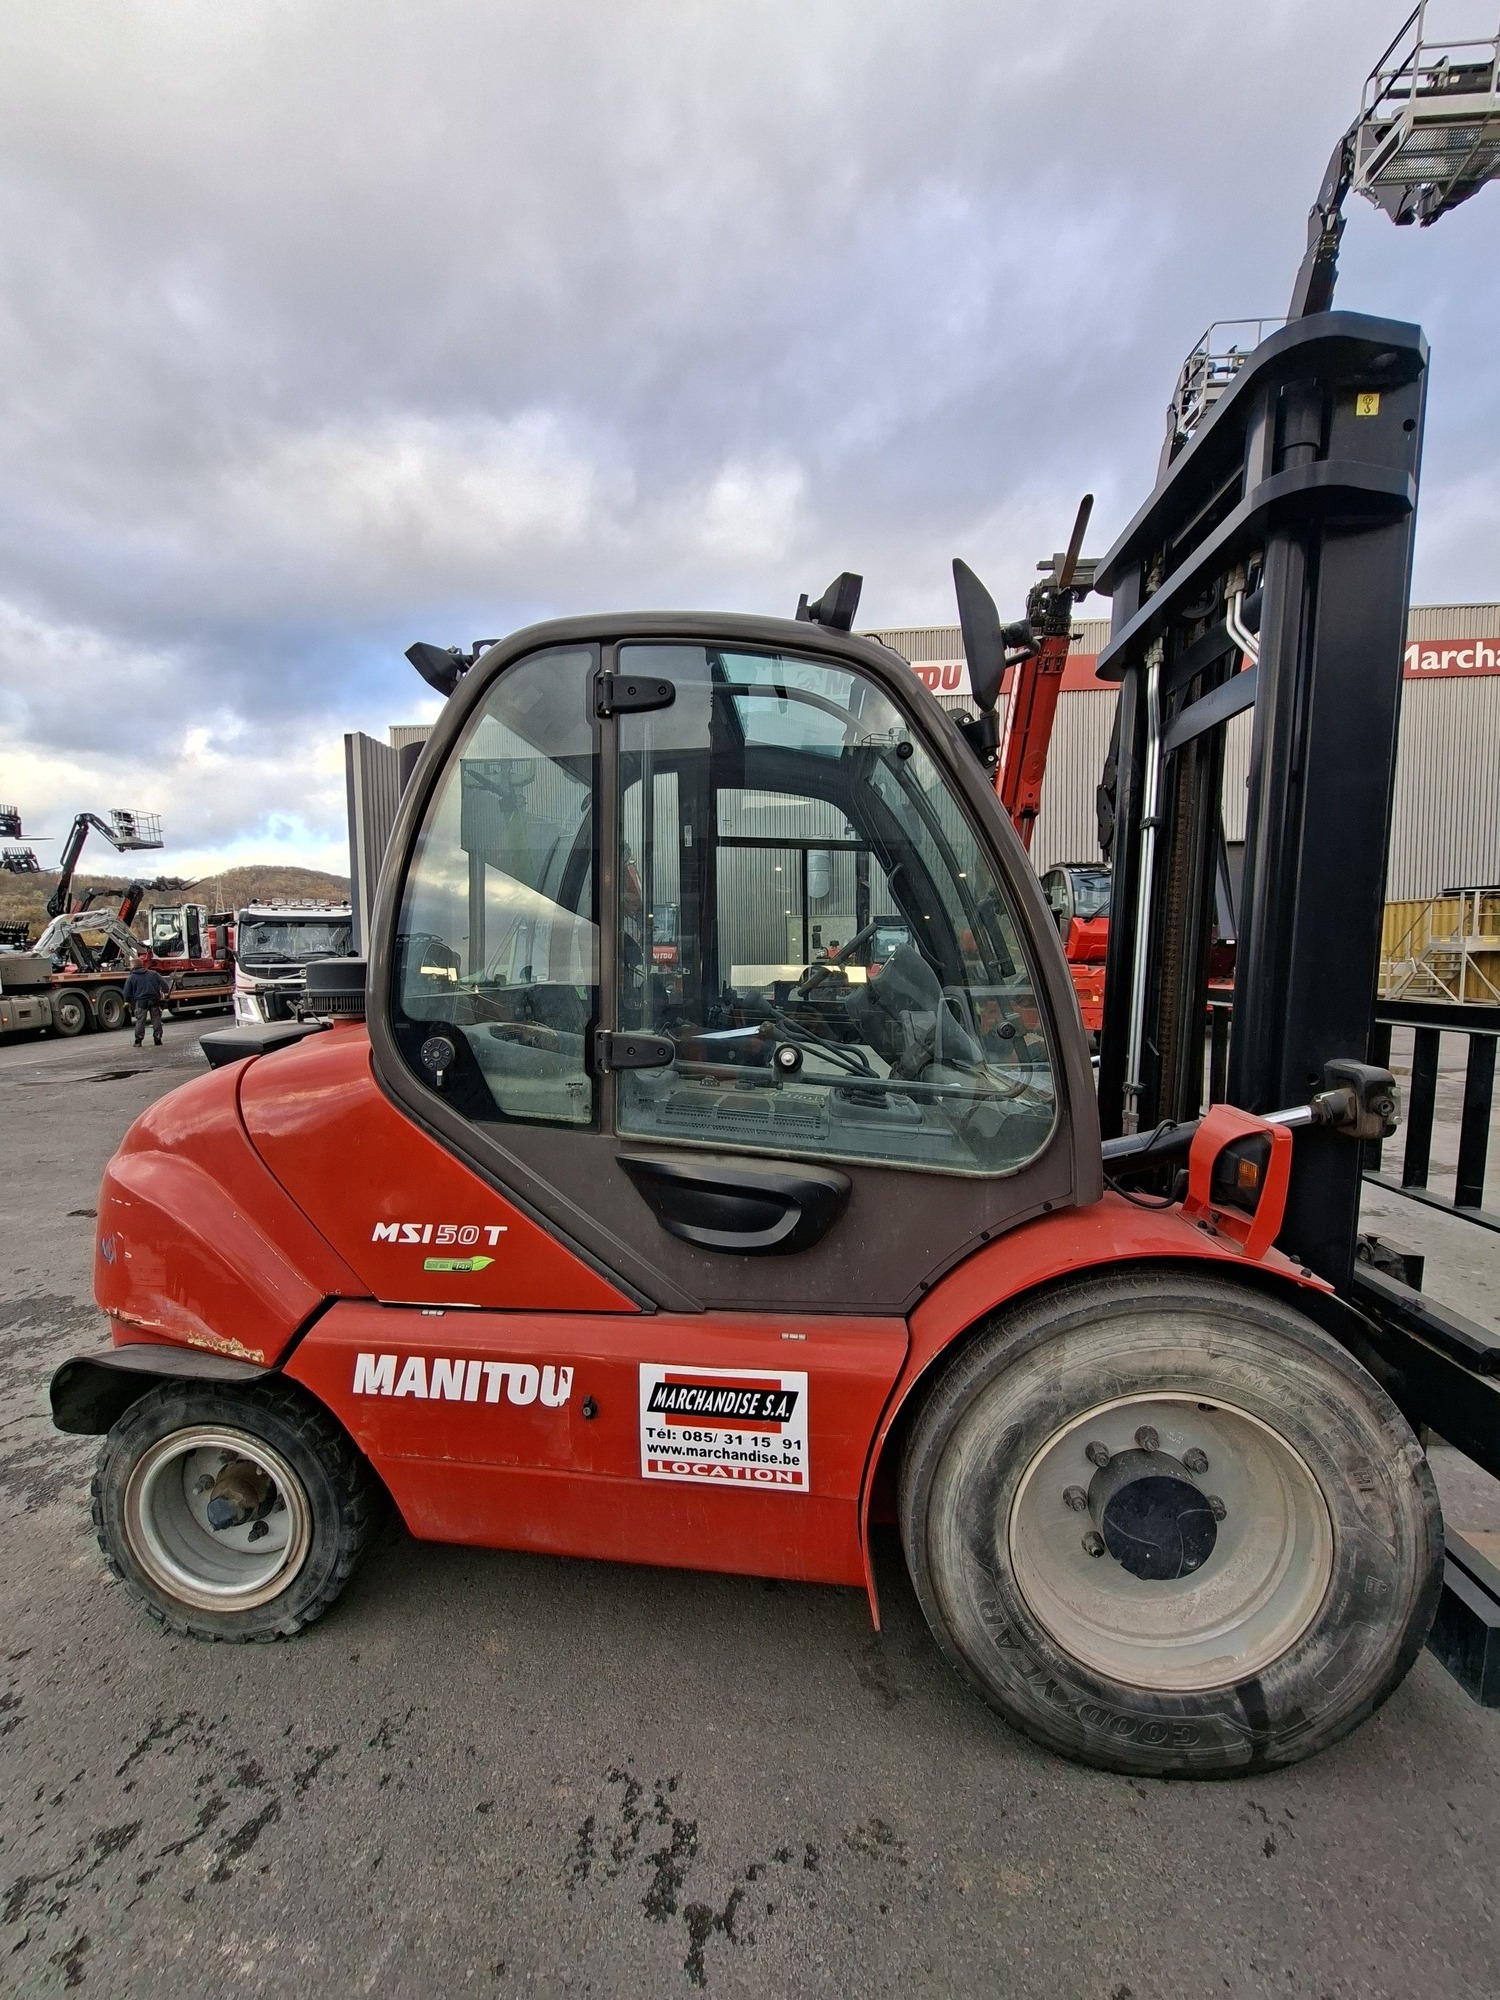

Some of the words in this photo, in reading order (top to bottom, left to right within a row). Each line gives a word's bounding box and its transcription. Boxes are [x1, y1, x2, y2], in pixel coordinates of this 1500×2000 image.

[1404, 641, 1500, 671] March
[352, 1352, 574, 1407] MANITOU
[653, 1386, 761, 1415] MARCHANDISE
[762, 1394, 791, 1418] S.A.
[646, 1427, 677, 1440] Tél:
[682, 1430, 719, 1444] 085/
[724, 1434, 743, 1446] 31
[751, 1436, 771, 1448] 15
[782, 1438, 801, 1451] 91
[647, 1443, 800, 1466] www.marchandise.be
[657, 1460, 793, 1484] LOCATION
